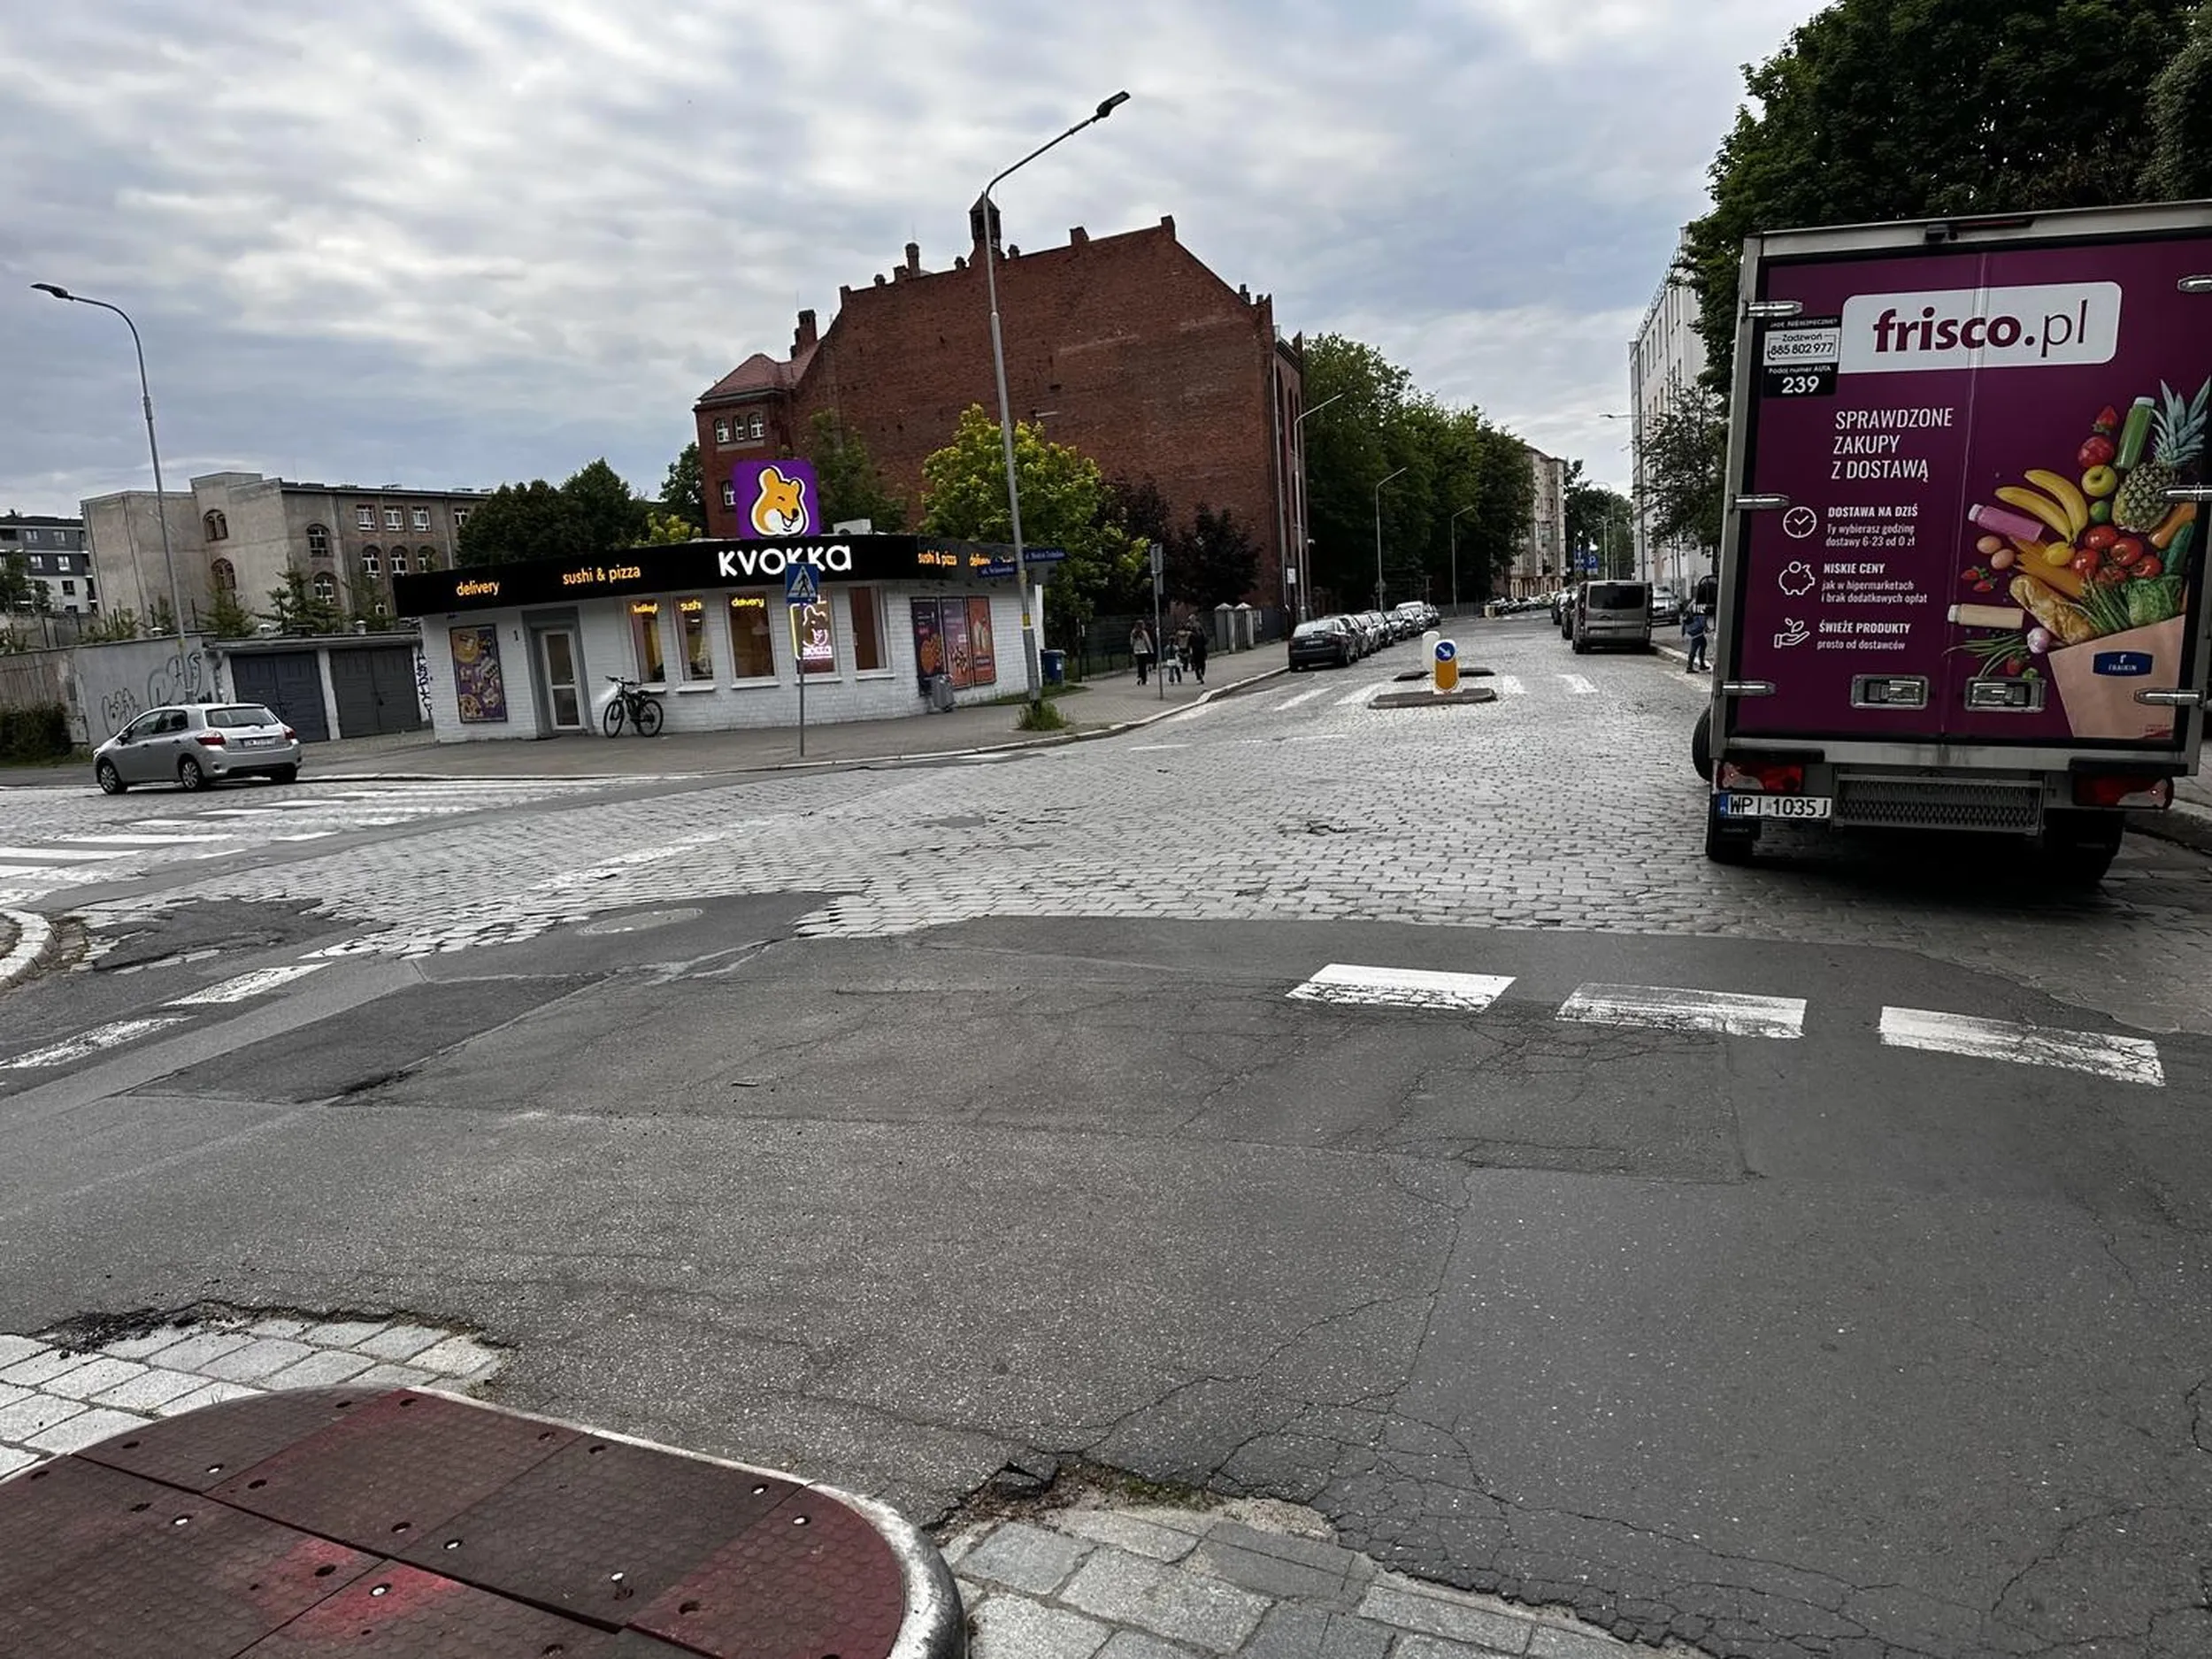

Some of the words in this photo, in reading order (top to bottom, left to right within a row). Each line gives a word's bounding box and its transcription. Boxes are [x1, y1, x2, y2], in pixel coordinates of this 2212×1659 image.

[1873, 299, 2088, 357] frisco.pl
[1782, 332, 1823, 342] Zadzwoń
[1792, 343, 1812, 354] 802
[1813, 342, 1833, 352] 977
[1781, 375, 1819, 394] 239
[1835, 408, 1954, 430] SPRAWDZONE
[1833, 434, 1901, 455] ZAKUPY
[1831, 460, 1841, 480] Z
[1846, 459, 1929, 483] DOSTAWĄ
[1827, 506, 1875, 518] DOSTAWA
[1878, 506, 1892, 518] NA
[1894, 503, 1918, 517] DZIŚ
[1827, 524, 1836, 535] Ty
[1838, 524, 1880, 535] wybierasz
[1882, 525, 1915, 536] godzinę
[1825, 536, 1860, 549] dostawy
[1862, 536, 1884, 547] 6-23
[1886, 536, 1896, 547] od
[1898, 536, 1905, 547] 0
[563, 567, 594, 585] sushi
[596, 567, 606, 581] &
[609, 565, 641, 584] pizza
[1823, 563, 1856, 574] NISKIE
[1859, 563, 1886, 574] CENY
[456, 580, 500, 596] delivery
[1822, 580, 1835, 592] jak
[1846, 580, 1915, 592] hipermarketach
[1826, 593, 1846, 603] brak
[1847, 593, 1902, 604] dodatkowych
[1904, 593, 1928, 605] opłat
[1818, 619, 1854, 634] ŚWIEŻE
[1856, 623, 1912, 634] PRODUKTY
[1816, 641, 1844, 650] prosto
[1846, 640, 1856, 649] od
[1858, 640, 1906, 650] dostawców
